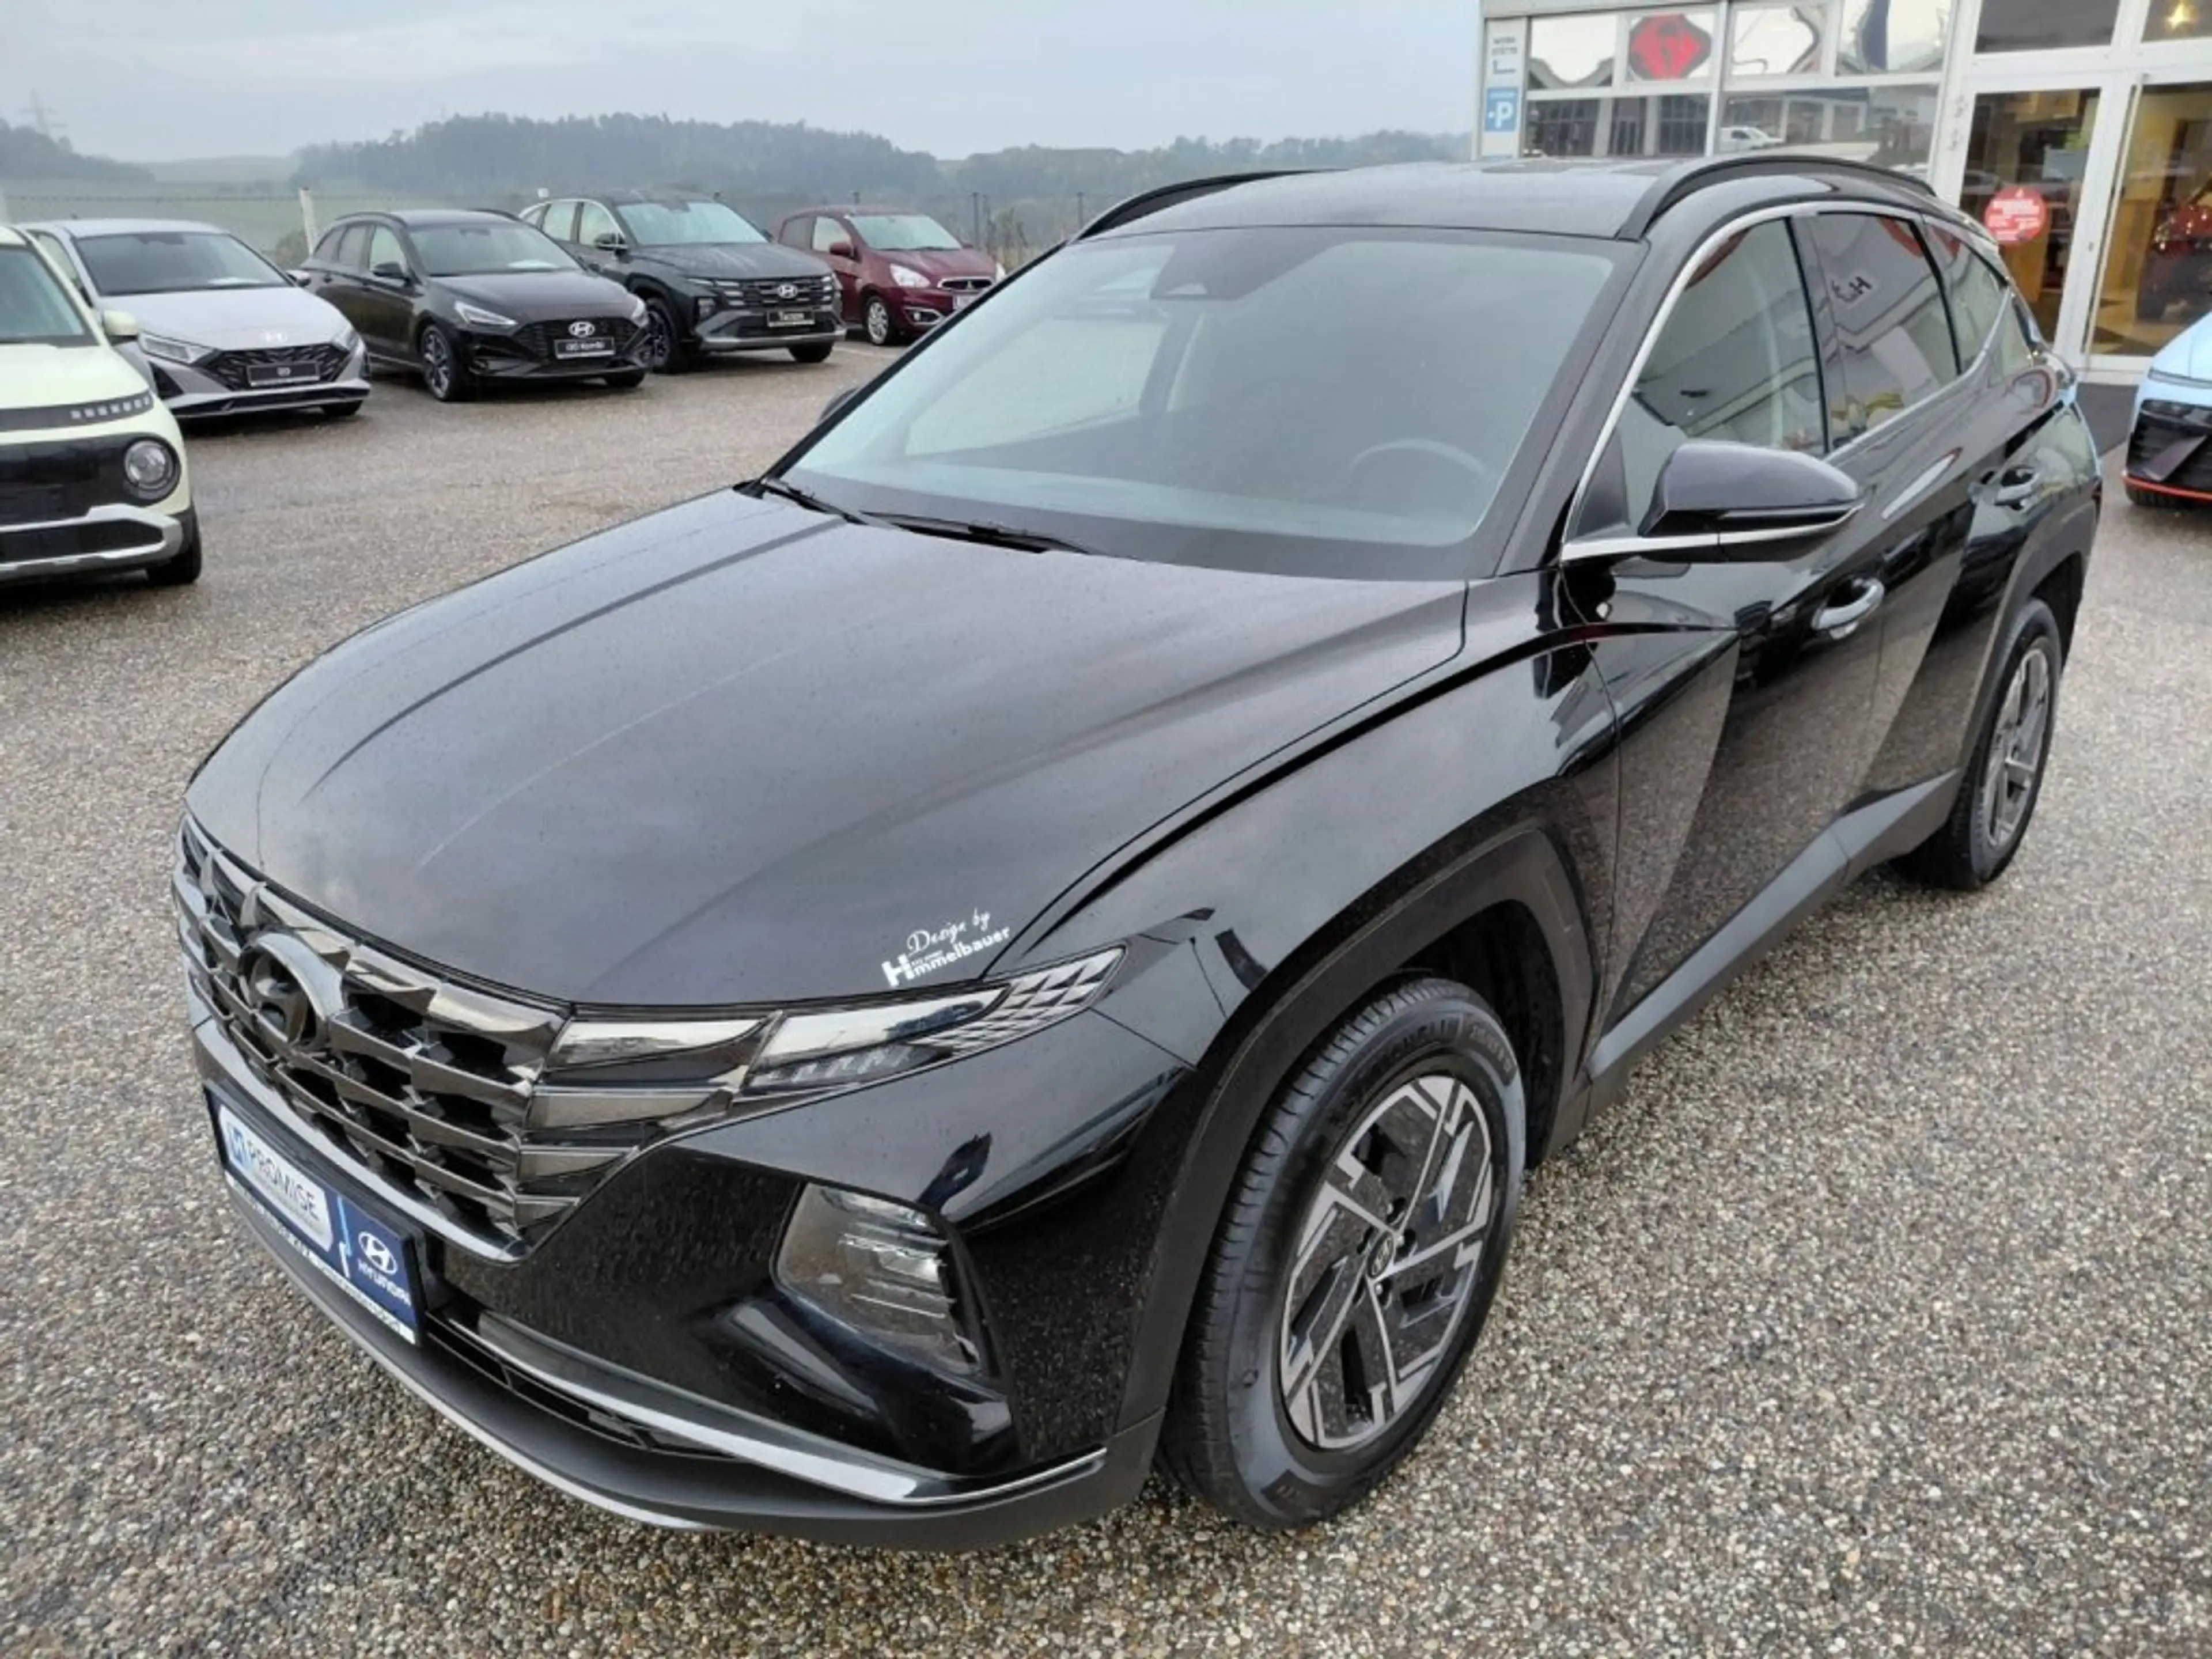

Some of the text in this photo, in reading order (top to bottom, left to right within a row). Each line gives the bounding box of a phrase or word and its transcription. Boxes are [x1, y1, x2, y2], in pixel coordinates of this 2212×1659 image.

[1495, 101, 1513, 128] P
[907, 908, 991, 956] Design by
[357, 1257, 411, 1308] HYUNDAI
